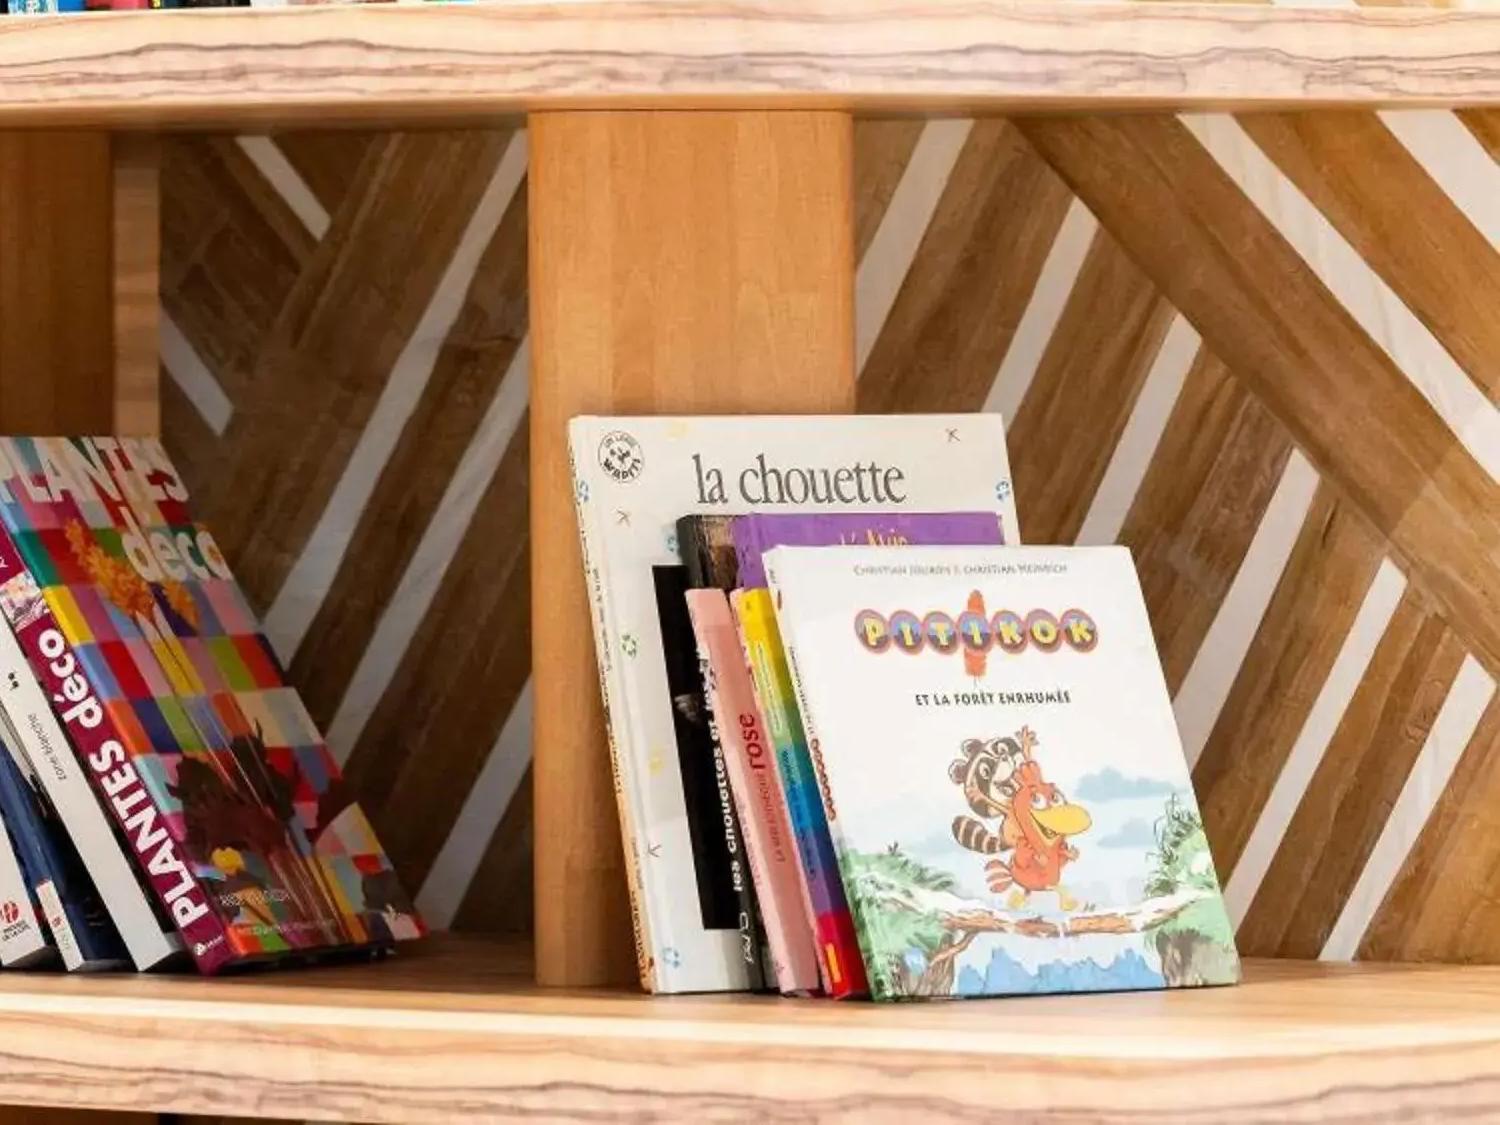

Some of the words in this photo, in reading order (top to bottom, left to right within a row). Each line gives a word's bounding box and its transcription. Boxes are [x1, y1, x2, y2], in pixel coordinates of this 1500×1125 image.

[603, 457, 641, 481] WAPITI
[692, 453, 728, 505] la
[739, 452, 909, 506] chouette
[853, 564, 908, 576] CHRISTIAN
[963, 563, 1017, 576] CHRISTIAN
[860, 614, 1095, 649] PITIKOK
[37, 629, 103, 728] déco
[915, 693, 929, 707] ET
[933, 693, 951, 707] LA
[954, 690, 995, 706] FORÊT
[998, 689, 1072, 705] ENRHUMÉE
[26, 713, 53, 755] blanche
[705, 718, 720, 742] et
[737, 711, 767, 772] rose
[47, 756, 67, 780] zone
[709, 745, 740, 853] chouettes
[88, 740, 208, 930] PLANTES
[727, 859, 744, 892] les
